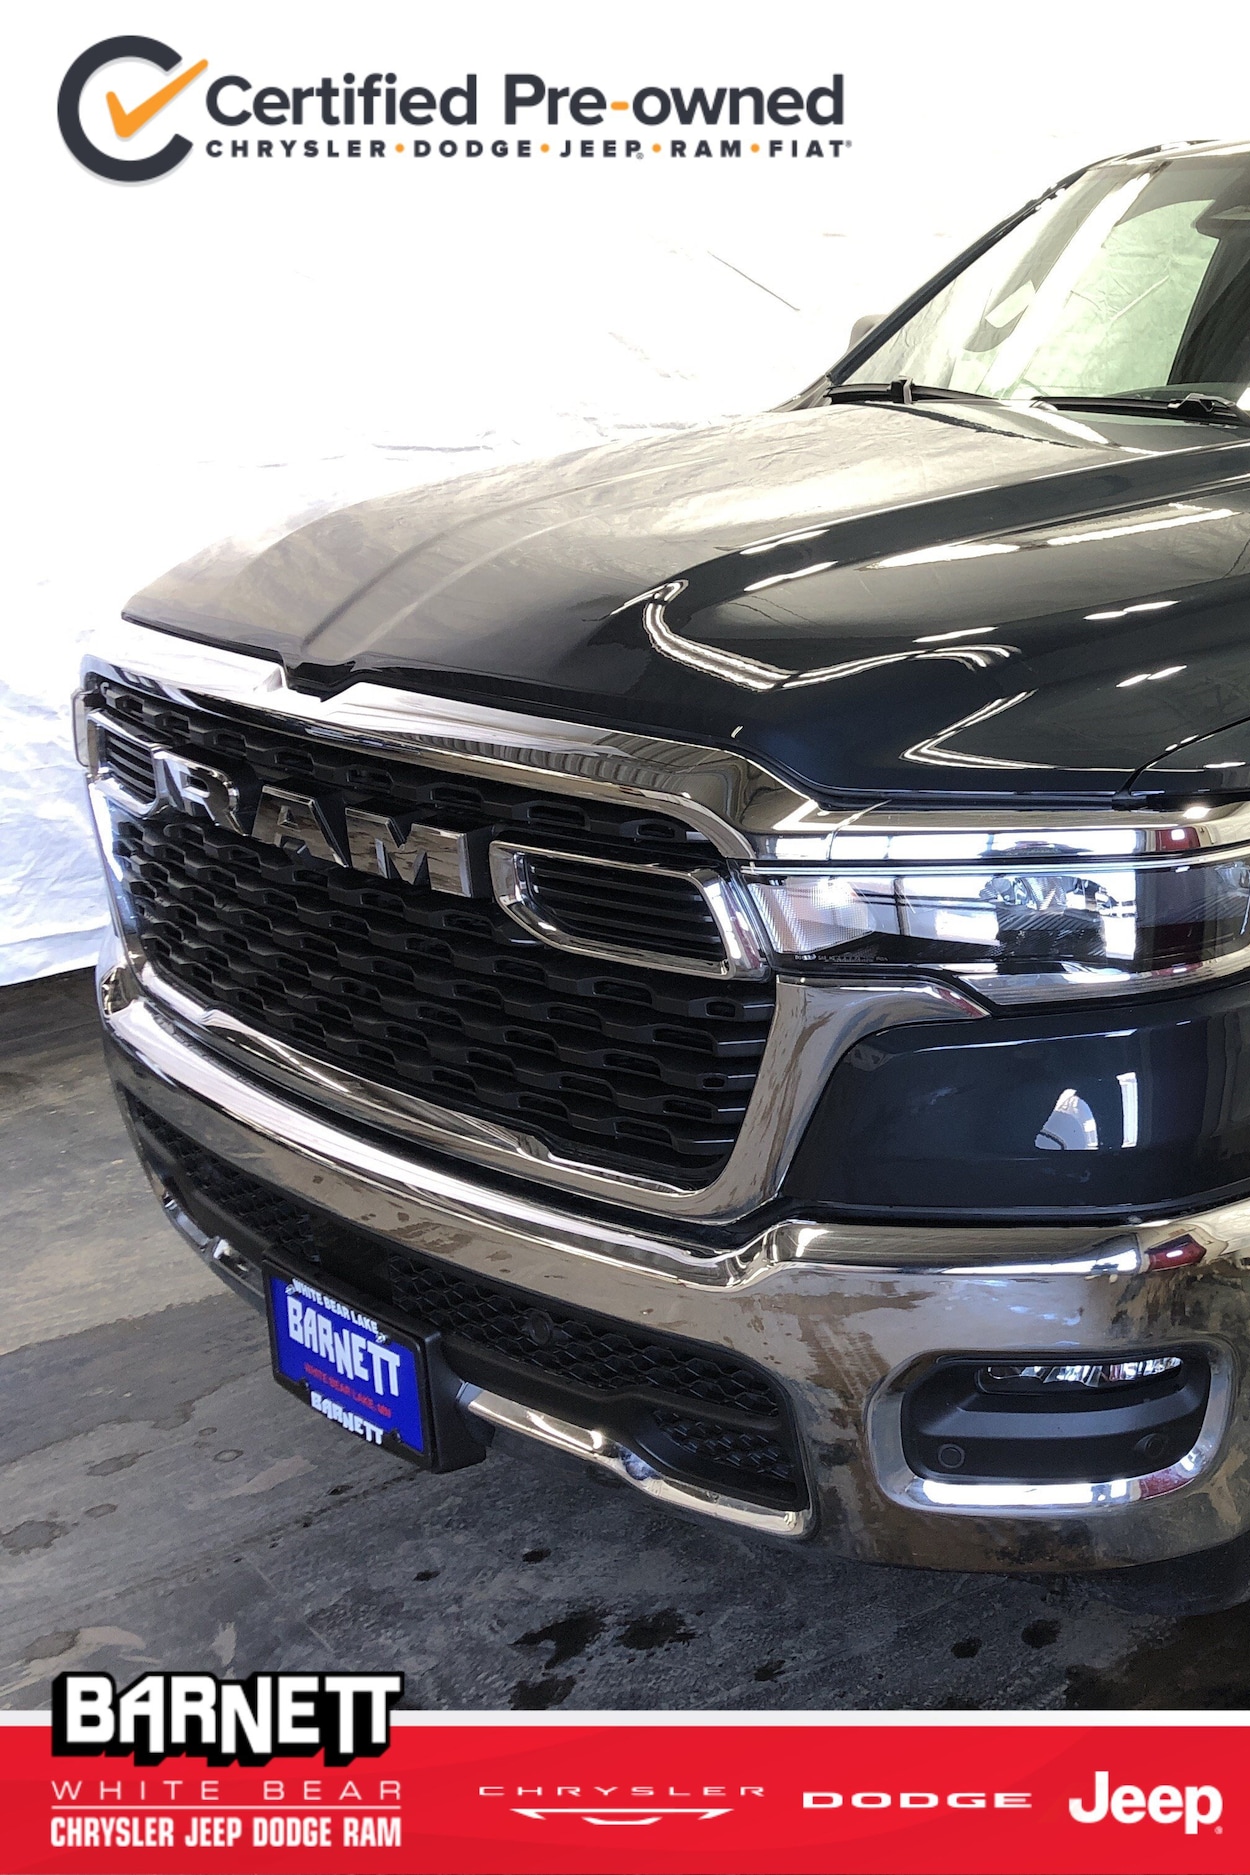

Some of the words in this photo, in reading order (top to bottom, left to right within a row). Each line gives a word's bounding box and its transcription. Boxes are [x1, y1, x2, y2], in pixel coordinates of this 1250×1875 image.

[155, 748, 474, 898] RAM
[286, 1295, 401, 1397] BARNETT
[292, 1278, 324, 1306] WHITE
[323, 1295, 351, 1321] BEAR
[350, 1310, 379, 1335] LAKE
[310, 1390, 384, 1445] BARNETT
